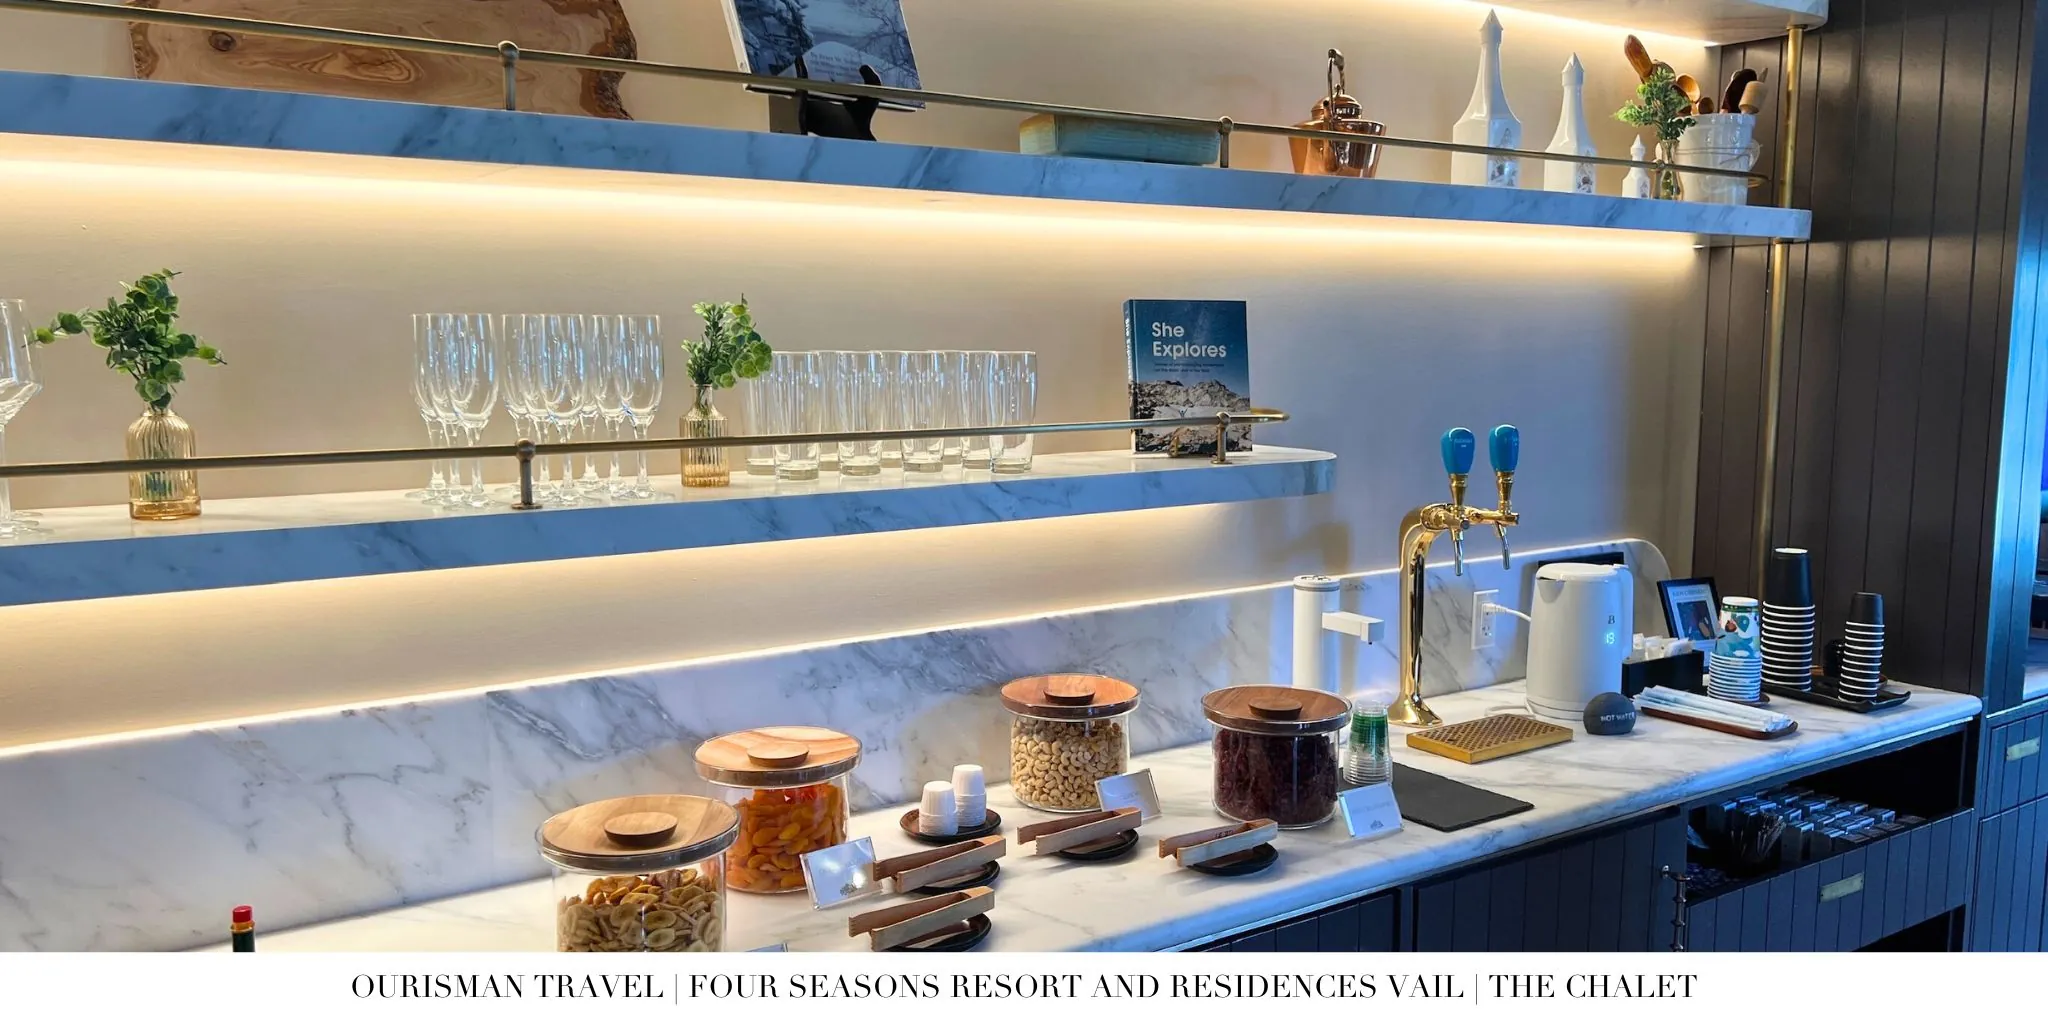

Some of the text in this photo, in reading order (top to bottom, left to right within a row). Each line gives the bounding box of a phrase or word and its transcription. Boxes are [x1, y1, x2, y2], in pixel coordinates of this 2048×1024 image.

[1152, 322, 1185, 338] She
[1153, 341, 1227, 360] Explores
[1600, 714, 1615, 722] HOT
